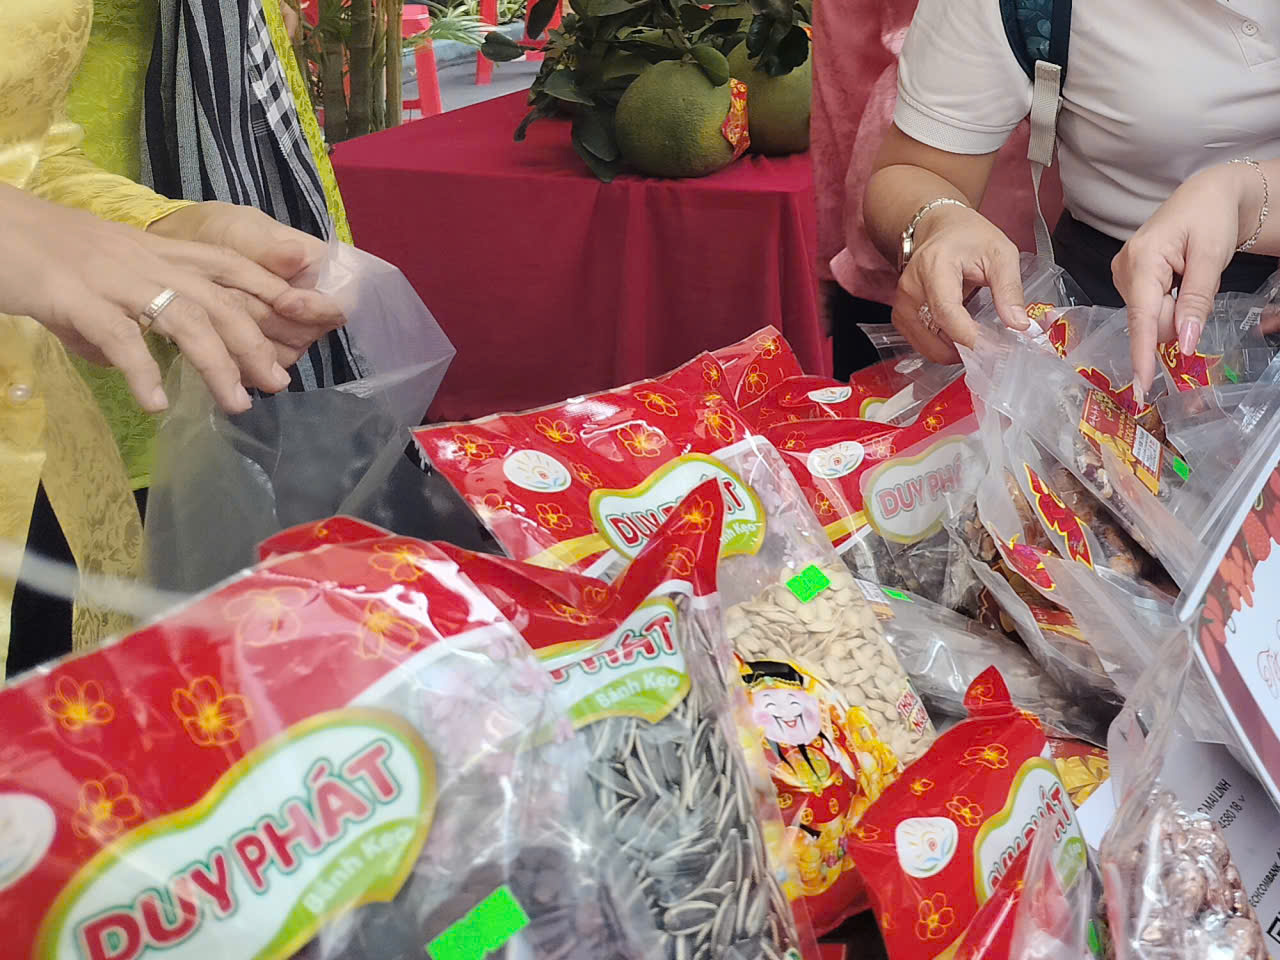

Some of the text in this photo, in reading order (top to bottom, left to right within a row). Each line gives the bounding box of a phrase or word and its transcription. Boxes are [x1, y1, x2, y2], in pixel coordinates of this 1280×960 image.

[876, 476, 927, 520] DUY
[595, 671, 680, 708] Bánh Kẹo
[1204, 792, 1218, 813] MAI
[1216, 778, 1232, 802] LINH
[77, 741, 399, 960] DUY PHÁT
[304, 855, 364, 912] Bánh
